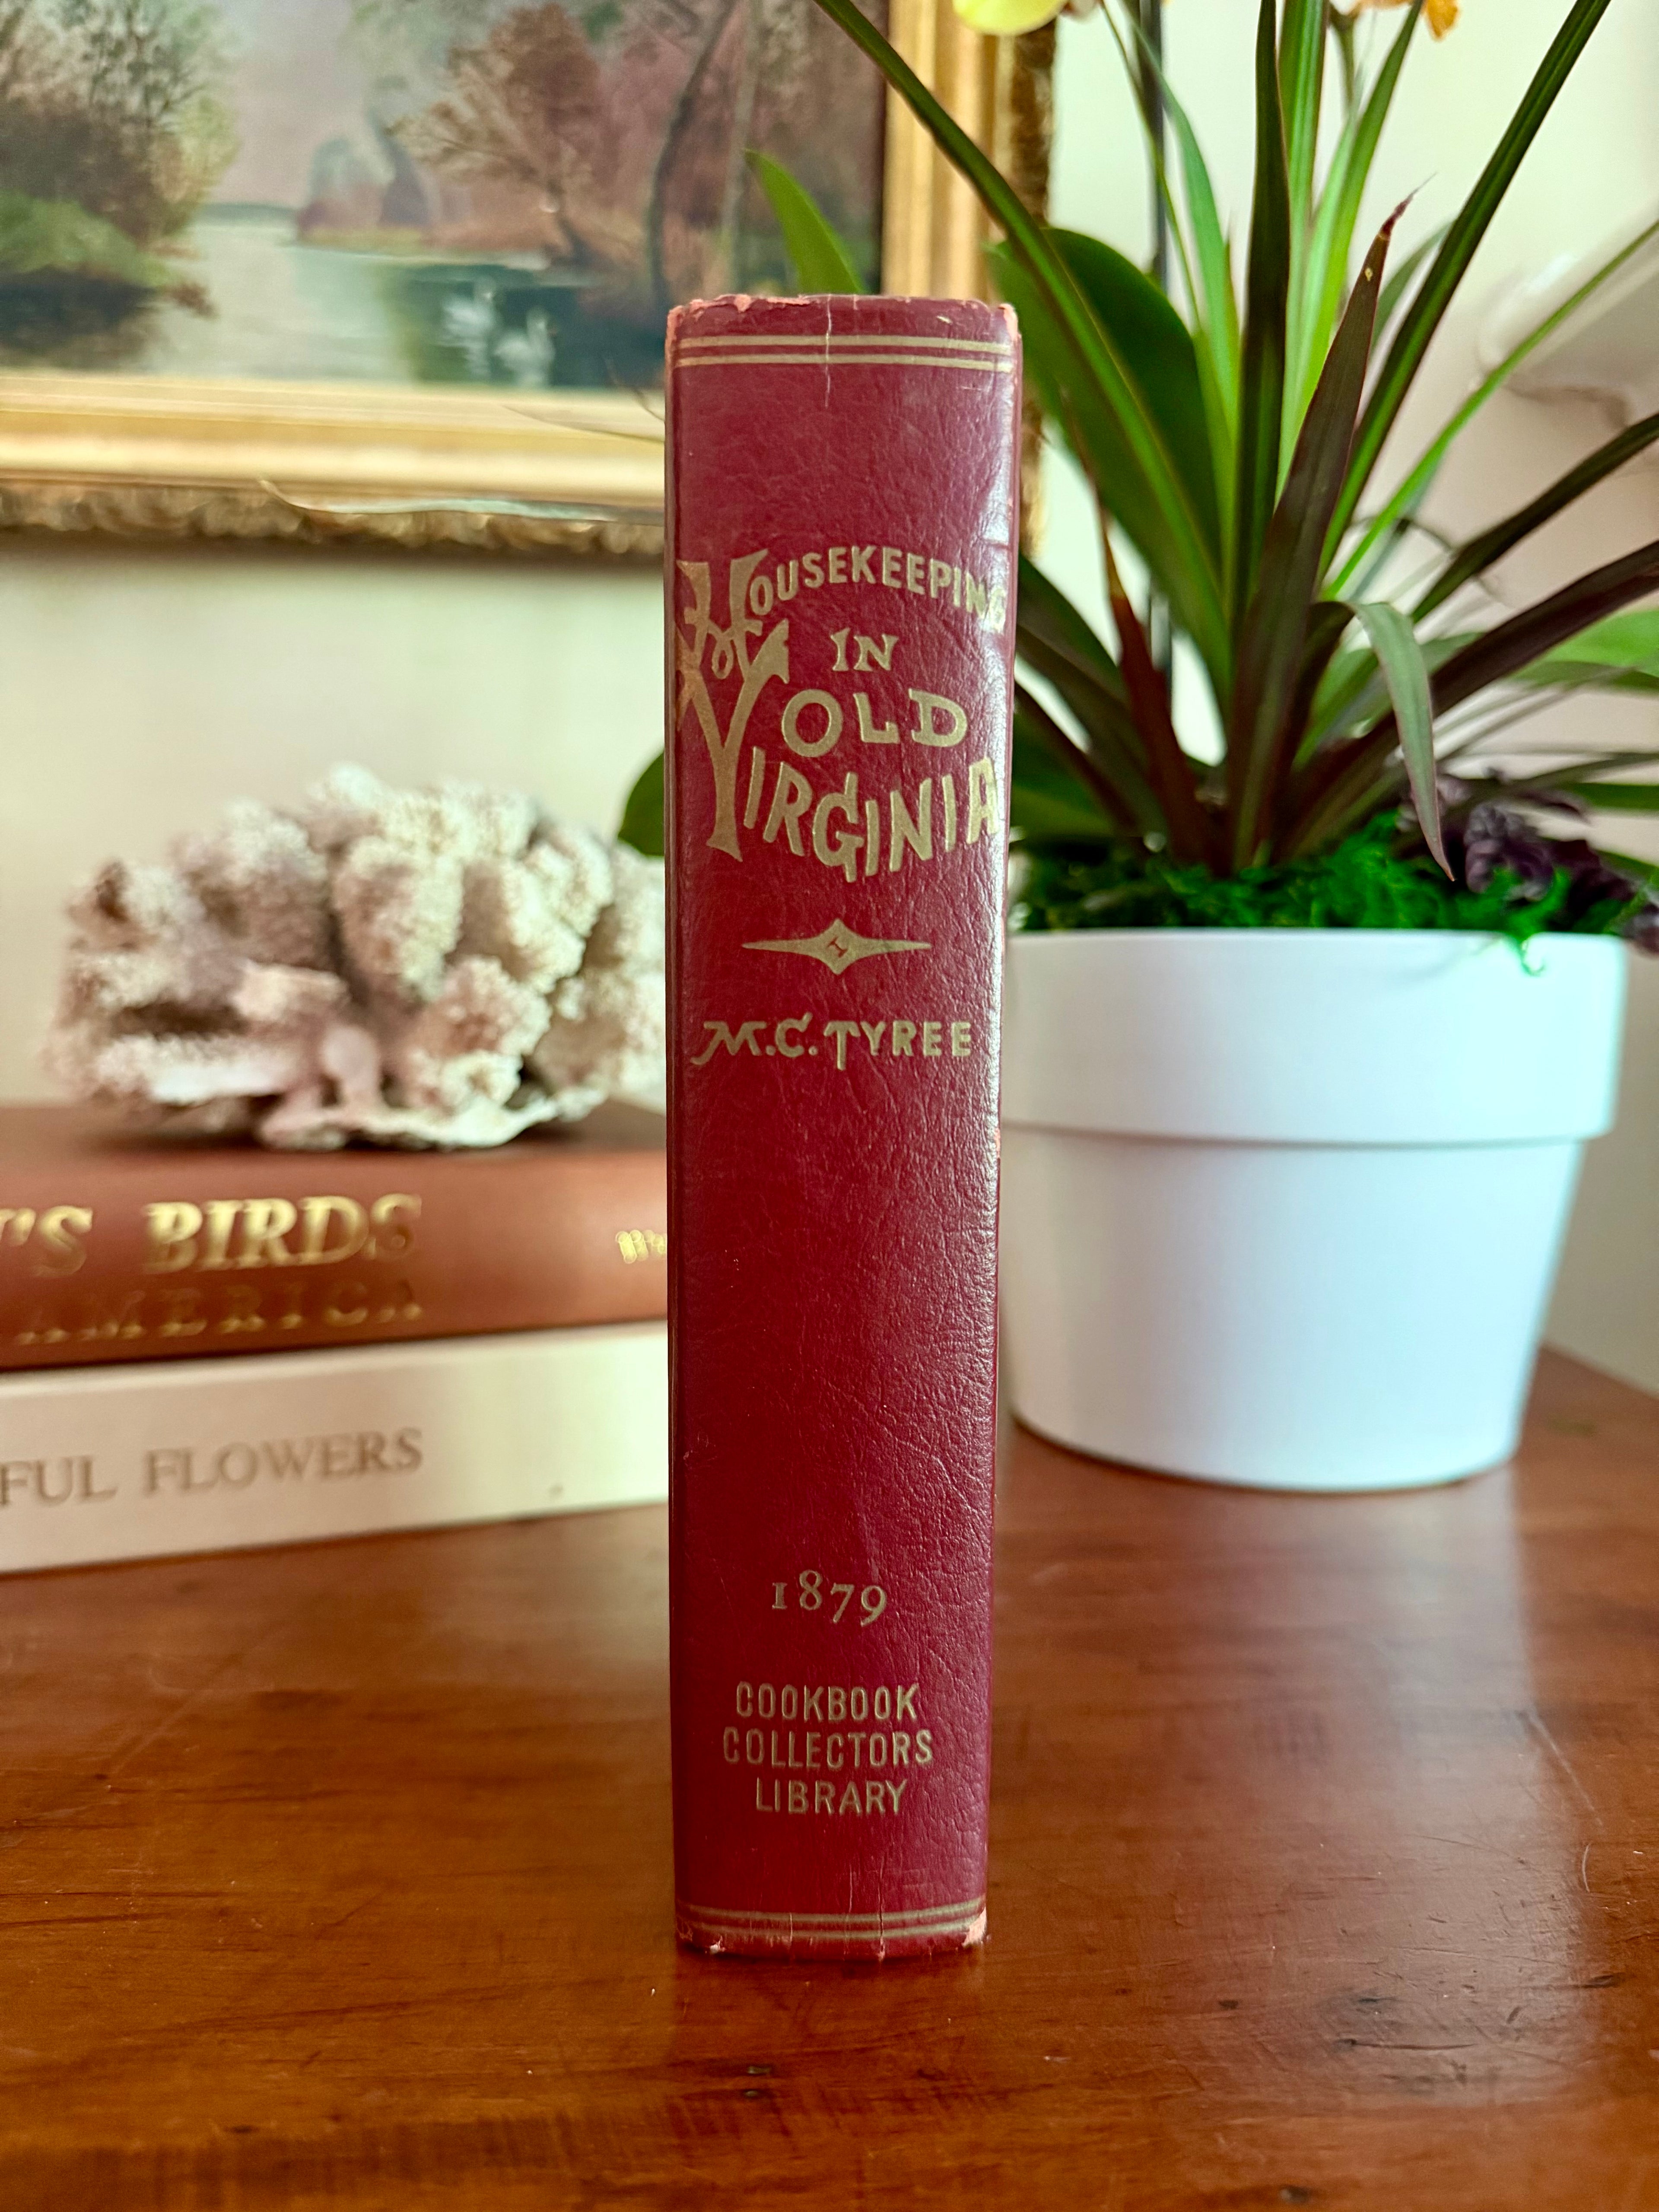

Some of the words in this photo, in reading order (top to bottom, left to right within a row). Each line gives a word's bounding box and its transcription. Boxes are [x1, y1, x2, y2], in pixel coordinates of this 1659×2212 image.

[676, 545, 1006, 679] HOUSEKEEPING
[830, 628, 899, 671] IN
[675, 619, 999, 883] VIRGINIA
[781, 688, 968, 758] OLD
[823, 1020, 971, 1071] TYREE
[143, 1193, 422, 1274] BIRDS
[143, 1427, 424, 1497] FLOWERS
[772, 1570, 887, 1627] 1879
[736, 1681, 919, 1723] COOKBOOK
[723, 1727, 933, 1770] COLLECTORS
[756, 1777, 908, 1815] LIBRARY
